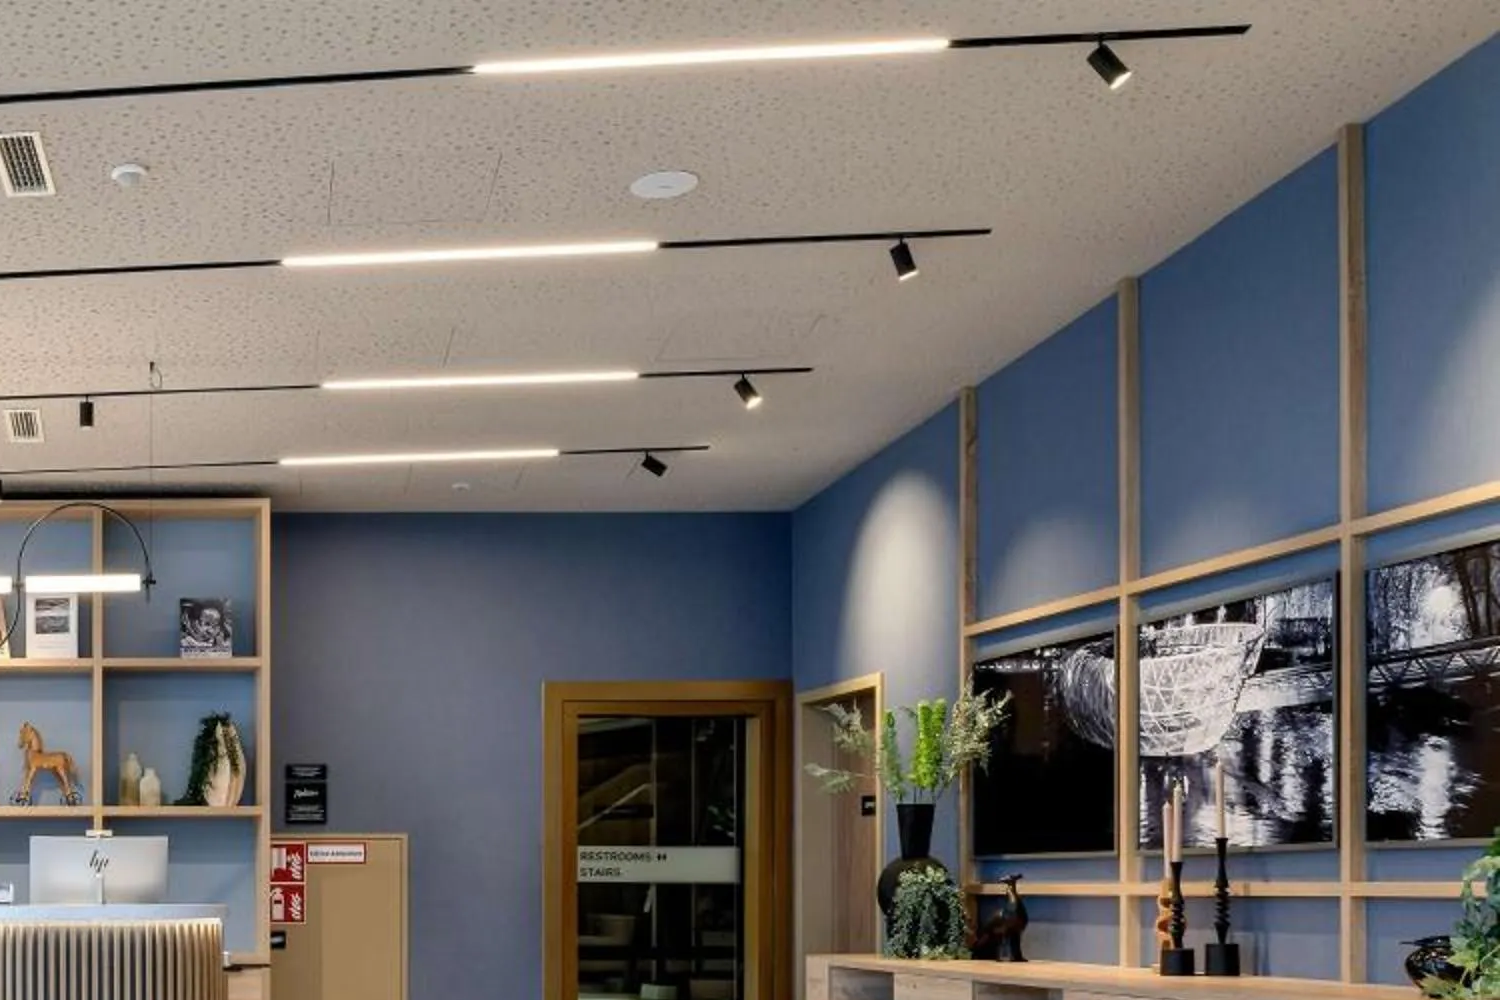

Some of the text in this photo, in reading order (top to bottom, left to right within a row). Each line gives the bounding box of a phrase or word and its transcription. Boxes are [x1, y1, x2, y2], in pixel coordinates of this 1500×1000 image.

[90, 848, 109, 873] hp
[579, 851, 653, 862] RESTROOMS
[579, 867, 622, 877] STAIRS
